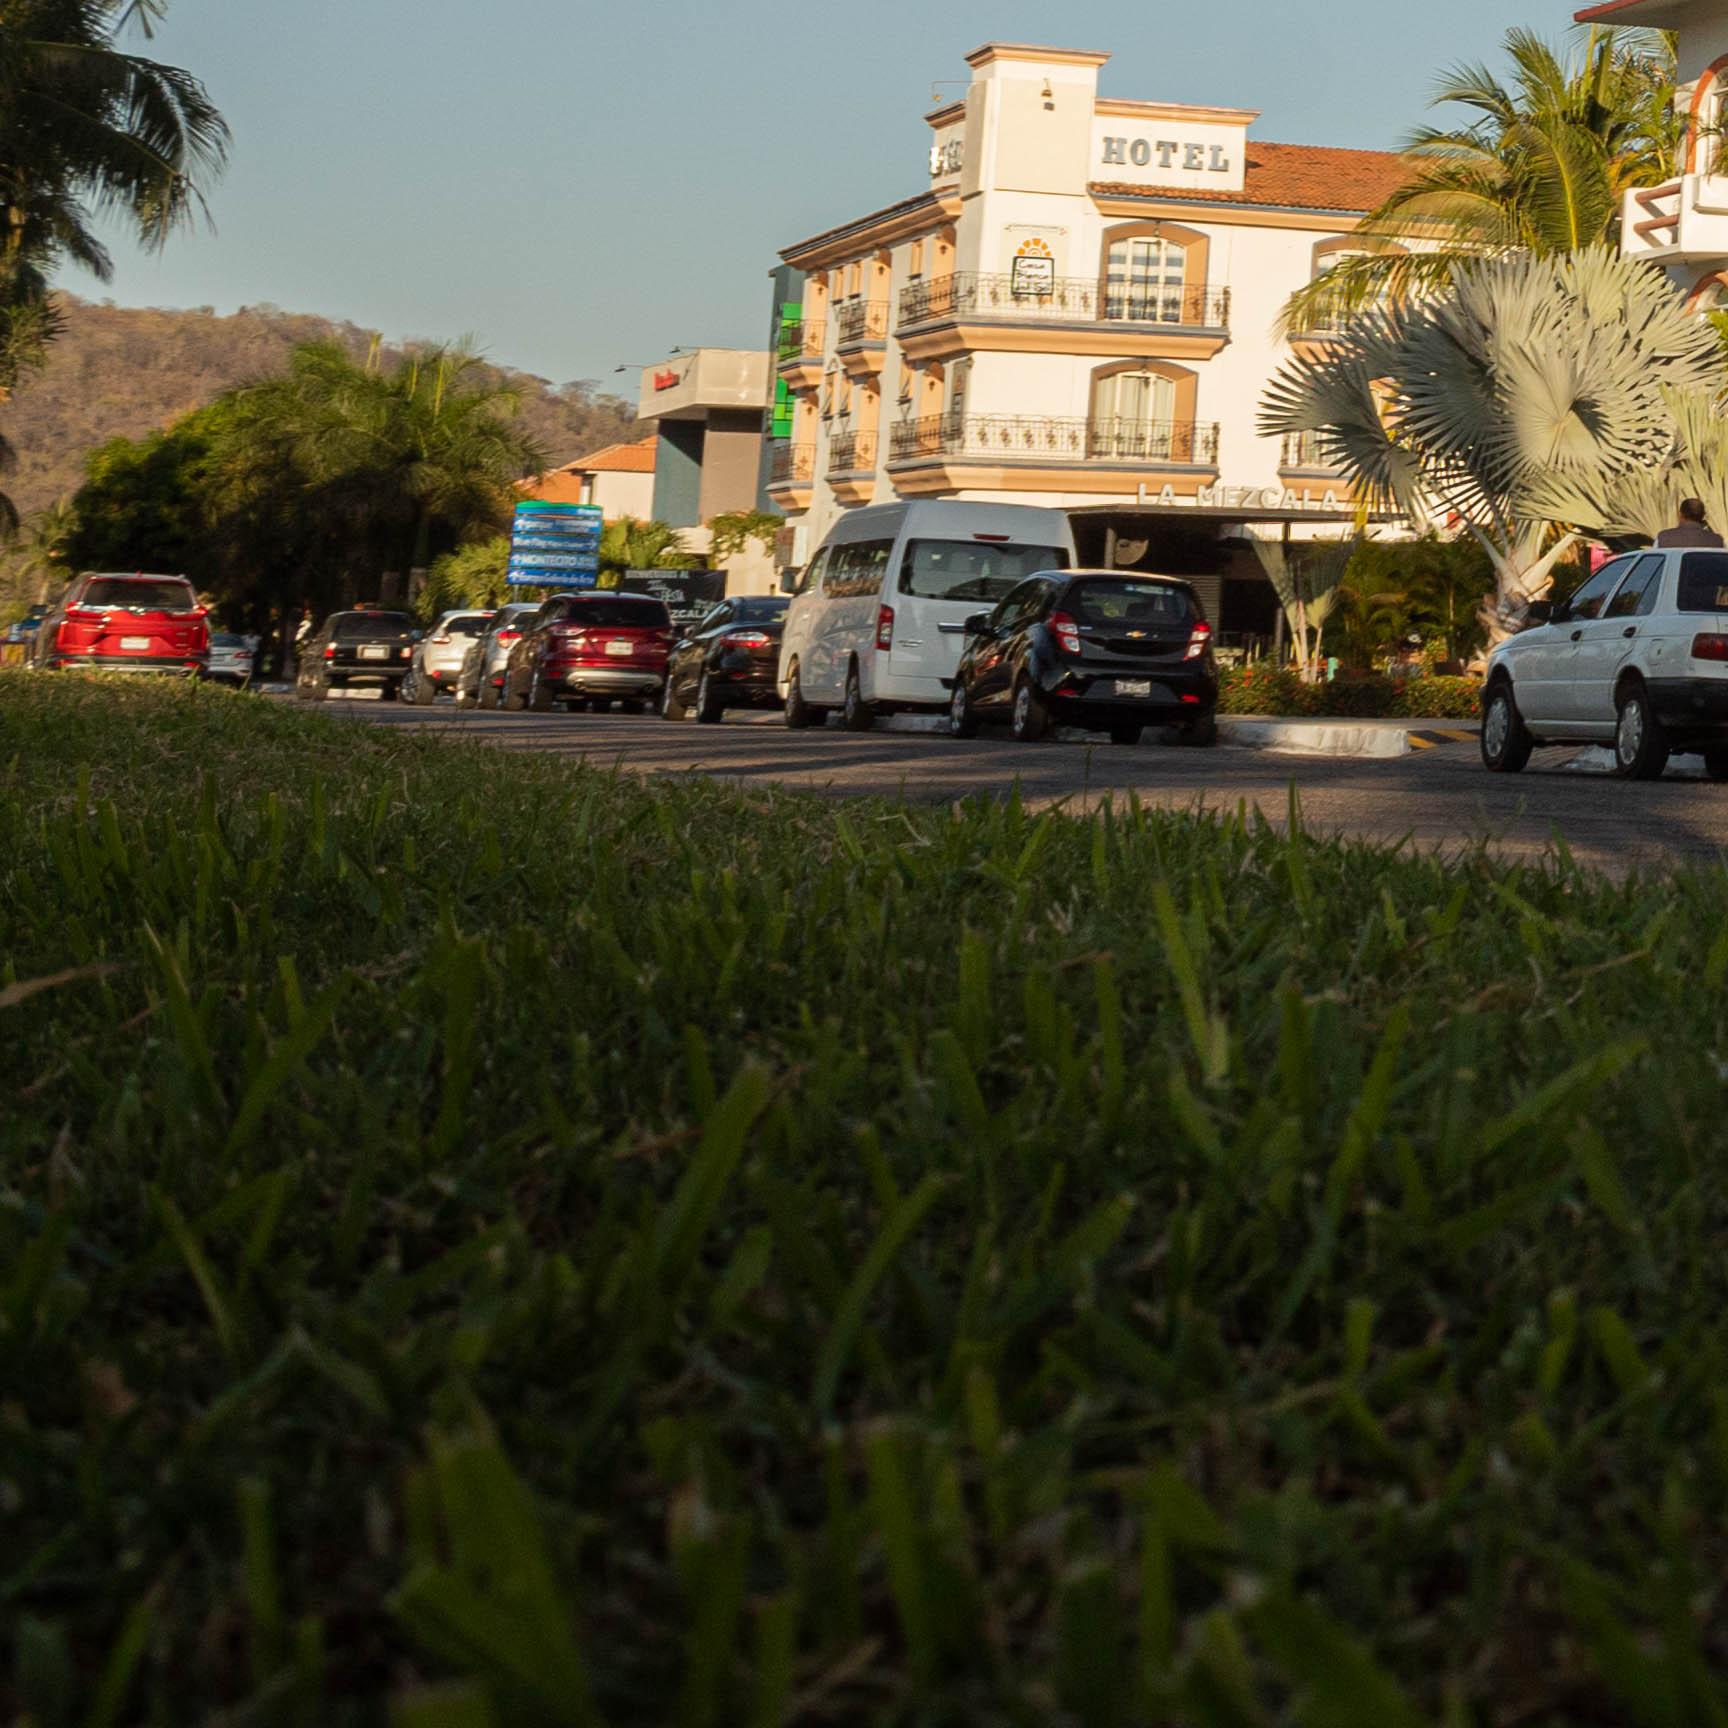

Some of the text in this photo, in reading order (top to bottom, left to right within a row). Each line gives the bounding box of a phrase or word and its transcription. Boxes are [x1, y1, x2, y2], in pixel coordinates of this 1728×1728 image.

[1102, 136, 1229, 171] HOTEL
[1137, 483, 1339, 511] LA MEZCALA
[671, 609, 708, 619] ZCALA
